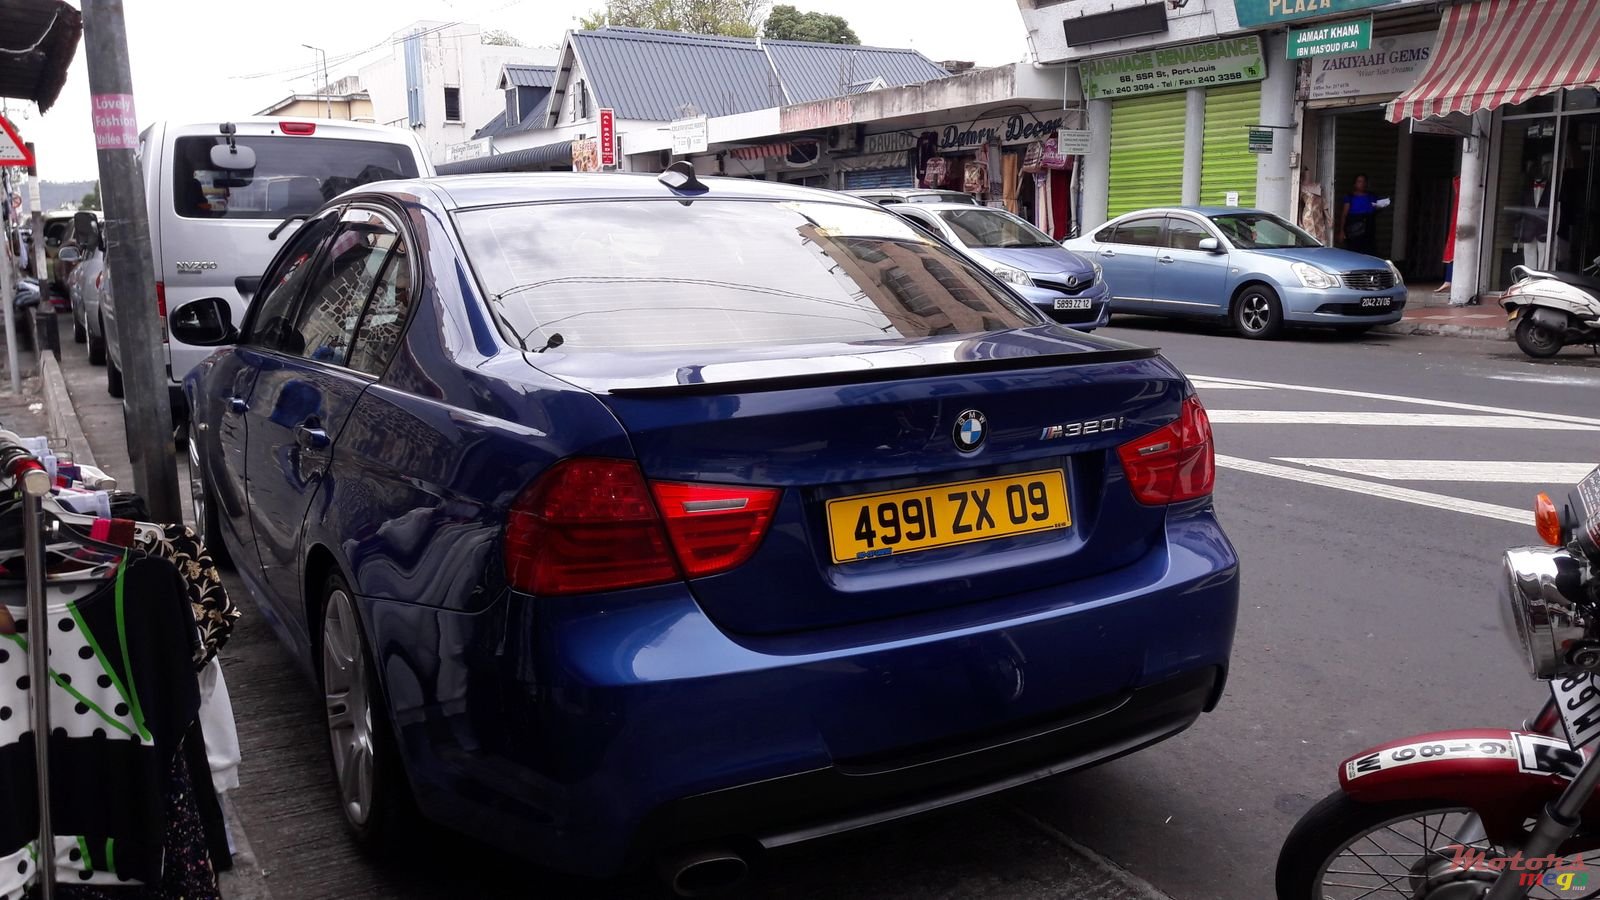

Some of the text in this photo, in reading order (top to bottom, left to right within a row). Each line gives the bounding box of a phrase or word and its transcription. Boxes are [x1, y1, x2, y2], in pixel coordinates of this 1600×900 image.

[1297, 24, 1360, 43] JAMAAT KHANA
[1079, 36, 1259, 78] PHARMACIE RENAISSANCE
[1296, 47, 1309, 57] IBN
[1322, 47, 1430, 71] ZAKIYAAH GEMS
[1136, 72, 1154, 81] SSR
[1171, 64, 1216, 76] Port-Louis
[1116, 86, 1131, 94] 240
[1133, 83, 1155, 92] 3094
[1161, 80, 1173, 88] Tel
[1179, 78, 1196, 87] Fax:
[1198, 75, 1216, 83] 240
[1217, 71, 1242, 81] 3358
[96, 97, 130, 112] Lovely
[96, 114, 136, 127] Fashion
[97, 132, 121, 145] Vallée
[176, 261, 217, 270] NV200
[1082, 299, 1090, 308] 12
[854, 481, 1050, 548] 4991 ZX 09
